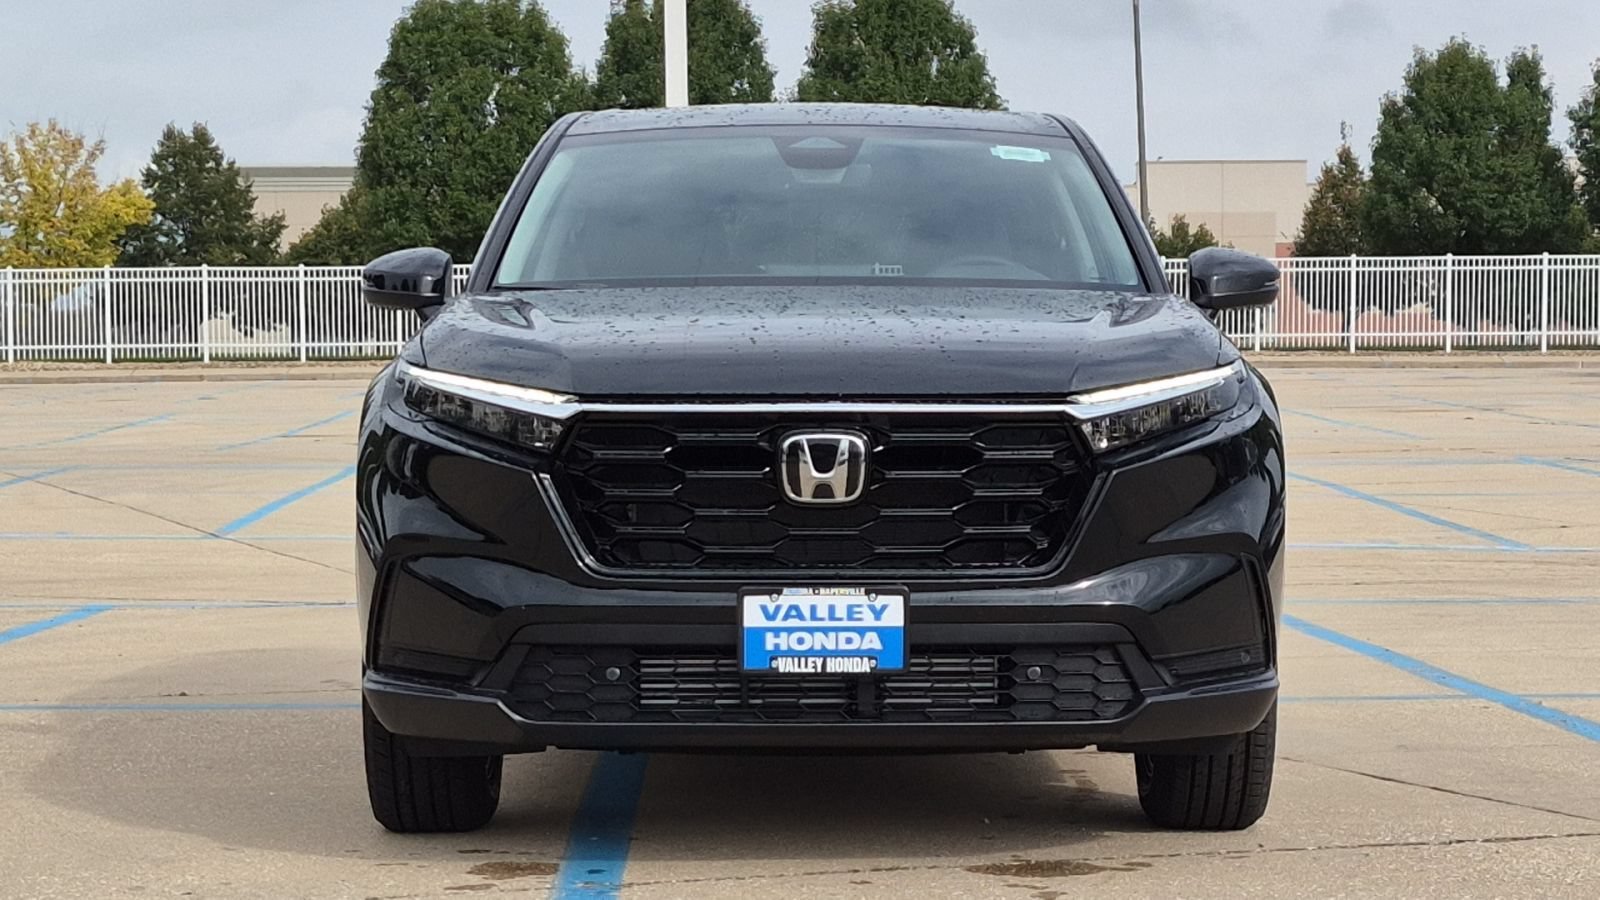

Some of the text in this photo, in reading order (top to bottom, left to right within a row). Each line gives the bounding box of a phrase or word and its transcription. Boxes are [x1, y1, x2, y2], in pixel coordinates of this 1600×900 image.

[760, 604, 889, 622] VALLEY
[765, 632, 883, 651] HONDA
[778, 656, 871, 673] VALLEY HONDA
